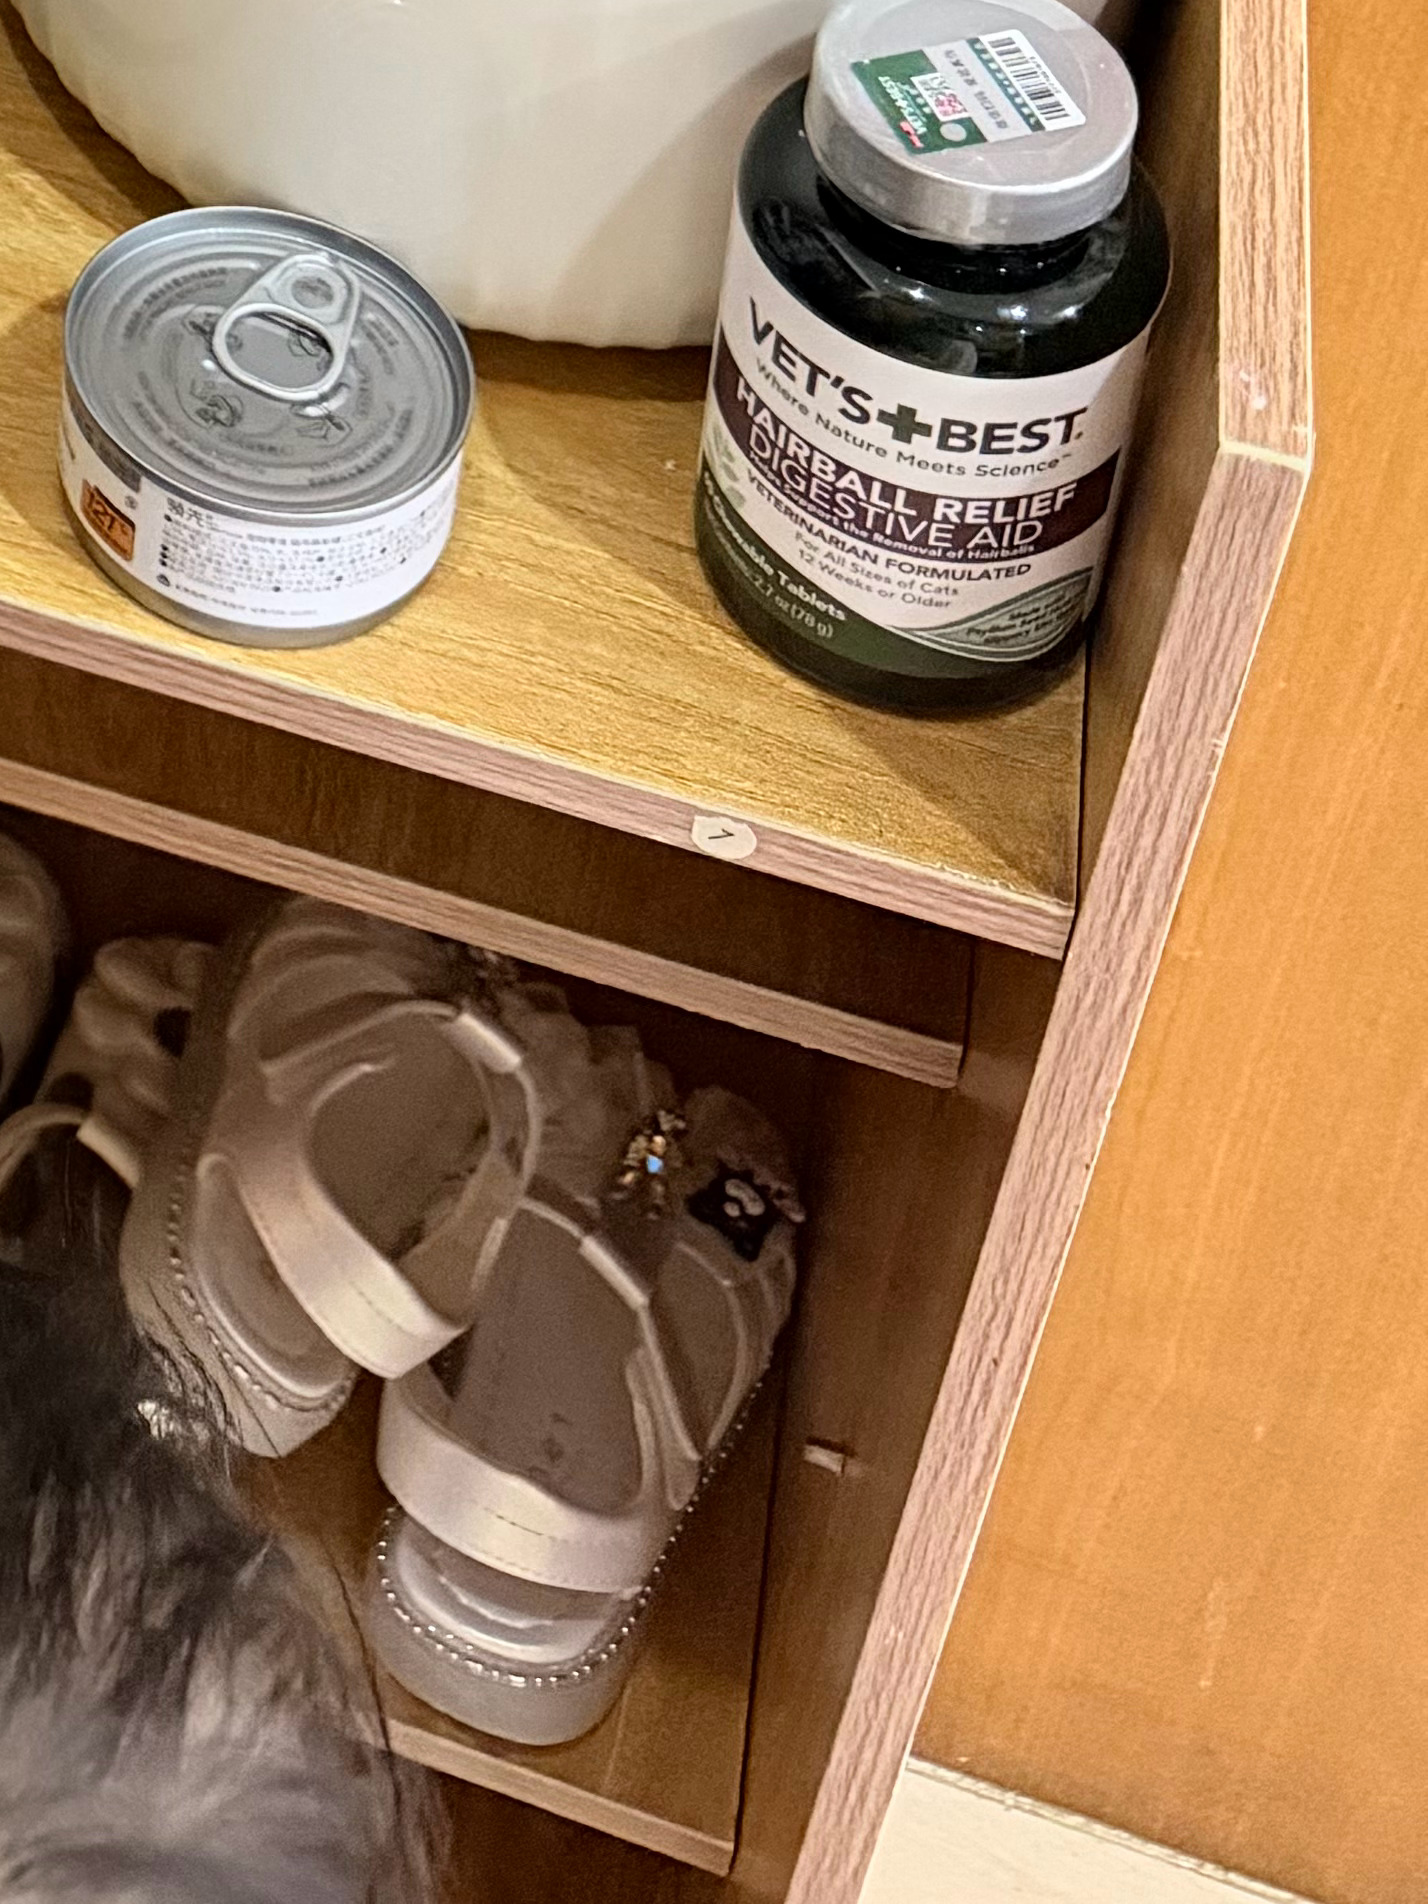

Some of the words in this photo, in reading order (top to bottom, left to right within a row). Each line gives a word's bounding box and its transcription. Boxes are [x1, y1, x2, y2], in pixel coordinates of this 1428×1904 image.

[736, 375, 919, 517] HAIRBALL
[933, 483, 1078, 527] RELIEF
[755, 356, 810, 416] Where
[814, 413, 888, 459] Nature
[895, 450, 967, 477] Meets
[746, 467, 879, 565] VETERINARIAN
[885, 558, 1032, 582] FORMULATED
[749, 423, 956, 548] DIGESTIVE
[966, 521, 1044, 547] AID
[795, 531, 821, 552] For
[825, 548, 847, 570] All
[849, 558, 892, 585] Sizes
[896, 577, 916, 591] of
[919, 580, 959, 596] Cats
[818, 560, 874, 594] Weeks
[876, 585, 895, 598] or
[901, 592, 952, 608] Older
[872, 532, 943, 558] Removal
[777, 569, 847, 621] Tablets
